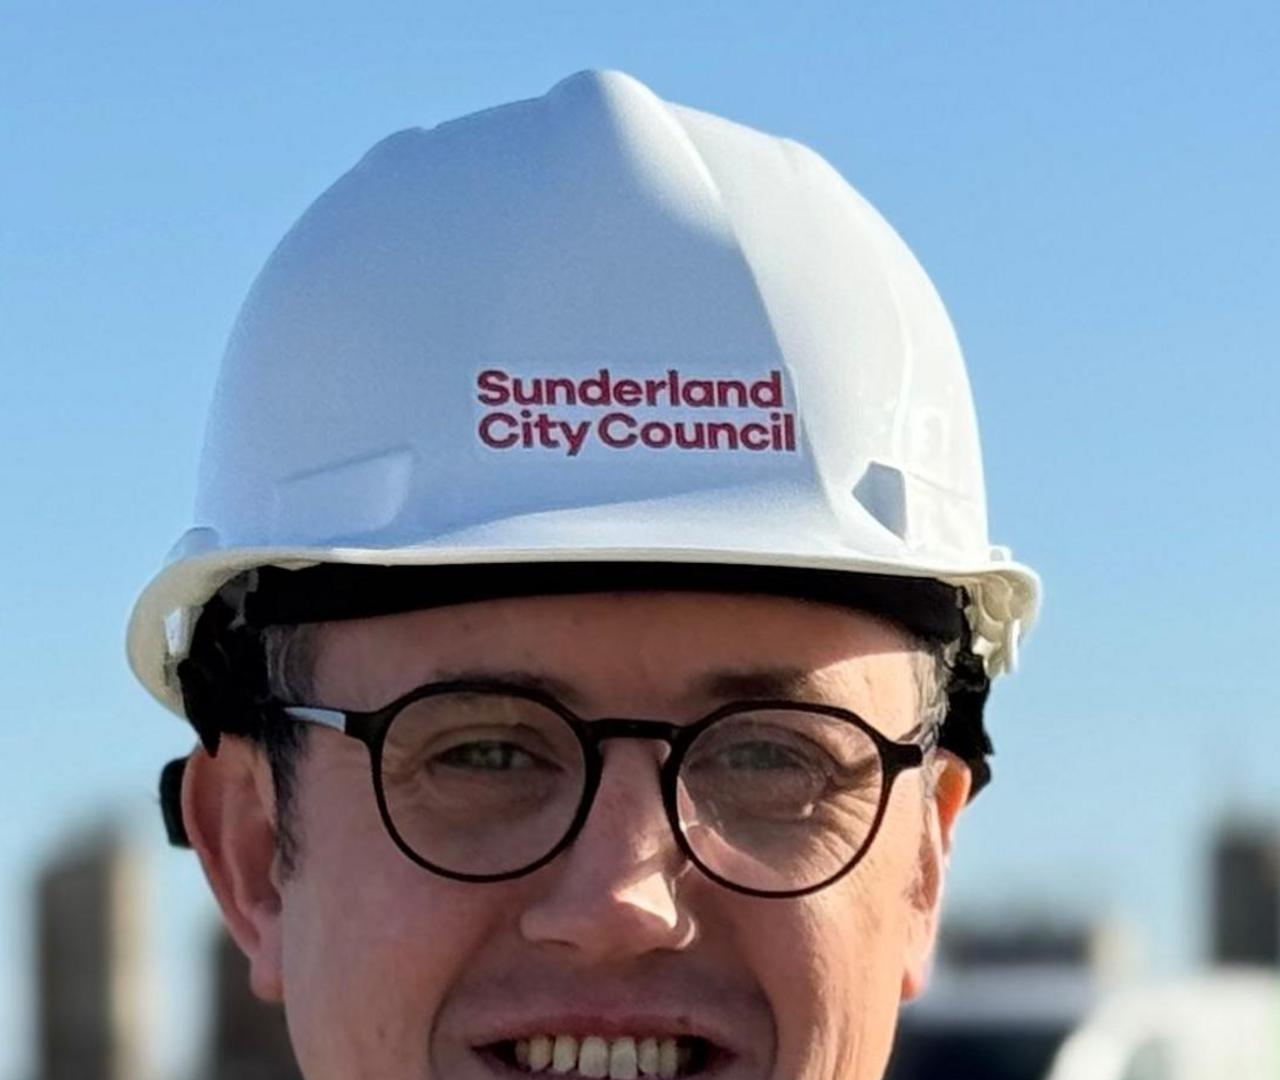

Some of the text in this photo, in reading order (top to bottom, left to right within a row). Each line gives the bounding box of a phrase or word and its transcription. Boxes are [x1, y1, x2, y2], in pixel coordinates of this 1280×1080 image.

[477, 369, 783, 408] Sunderland
[478, 410, 796, 456] City Council
